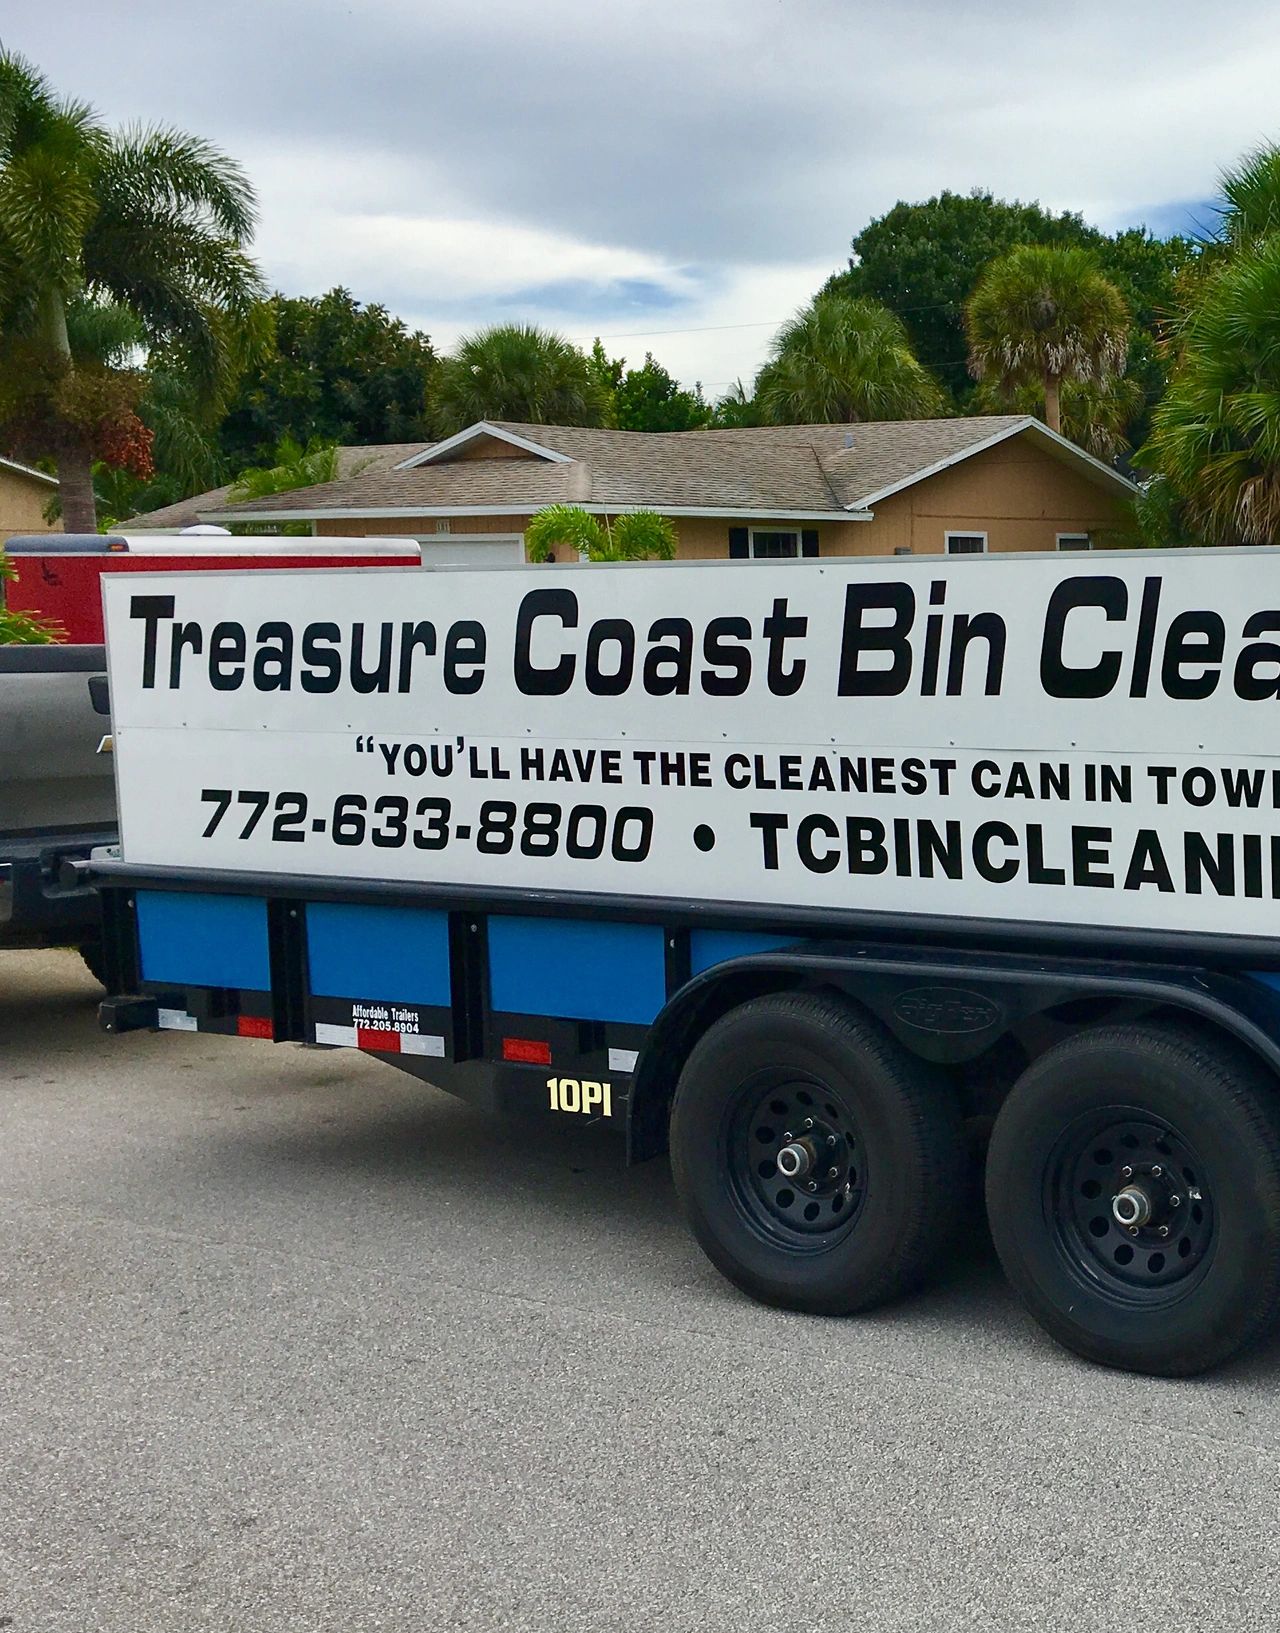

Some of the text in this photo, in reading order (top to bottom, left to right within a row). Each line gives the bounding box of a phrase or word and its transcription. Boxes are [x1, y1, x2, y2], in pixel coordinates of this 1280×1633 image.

[129, 594, 487, 695] Treasure
[513, 588, 809, 697] Coast
[837, 580, 1007, 697] Bin
[520, 747, 623, 784] HAVE
[632, 750, 713, 788] THE
[724, 753, 957, 797] CLEANEST
[971, 759, 1070, 801] CAN
[1084, 763, 1132, 804] IN
[200, 788, 654, 863] 772-633-8800
[352, 1004, 419, 1022] Affordable Trailers
[352, 1018, 420, 1034] 772.205.8904
[546, 1077, 612, 1117] 10PI
